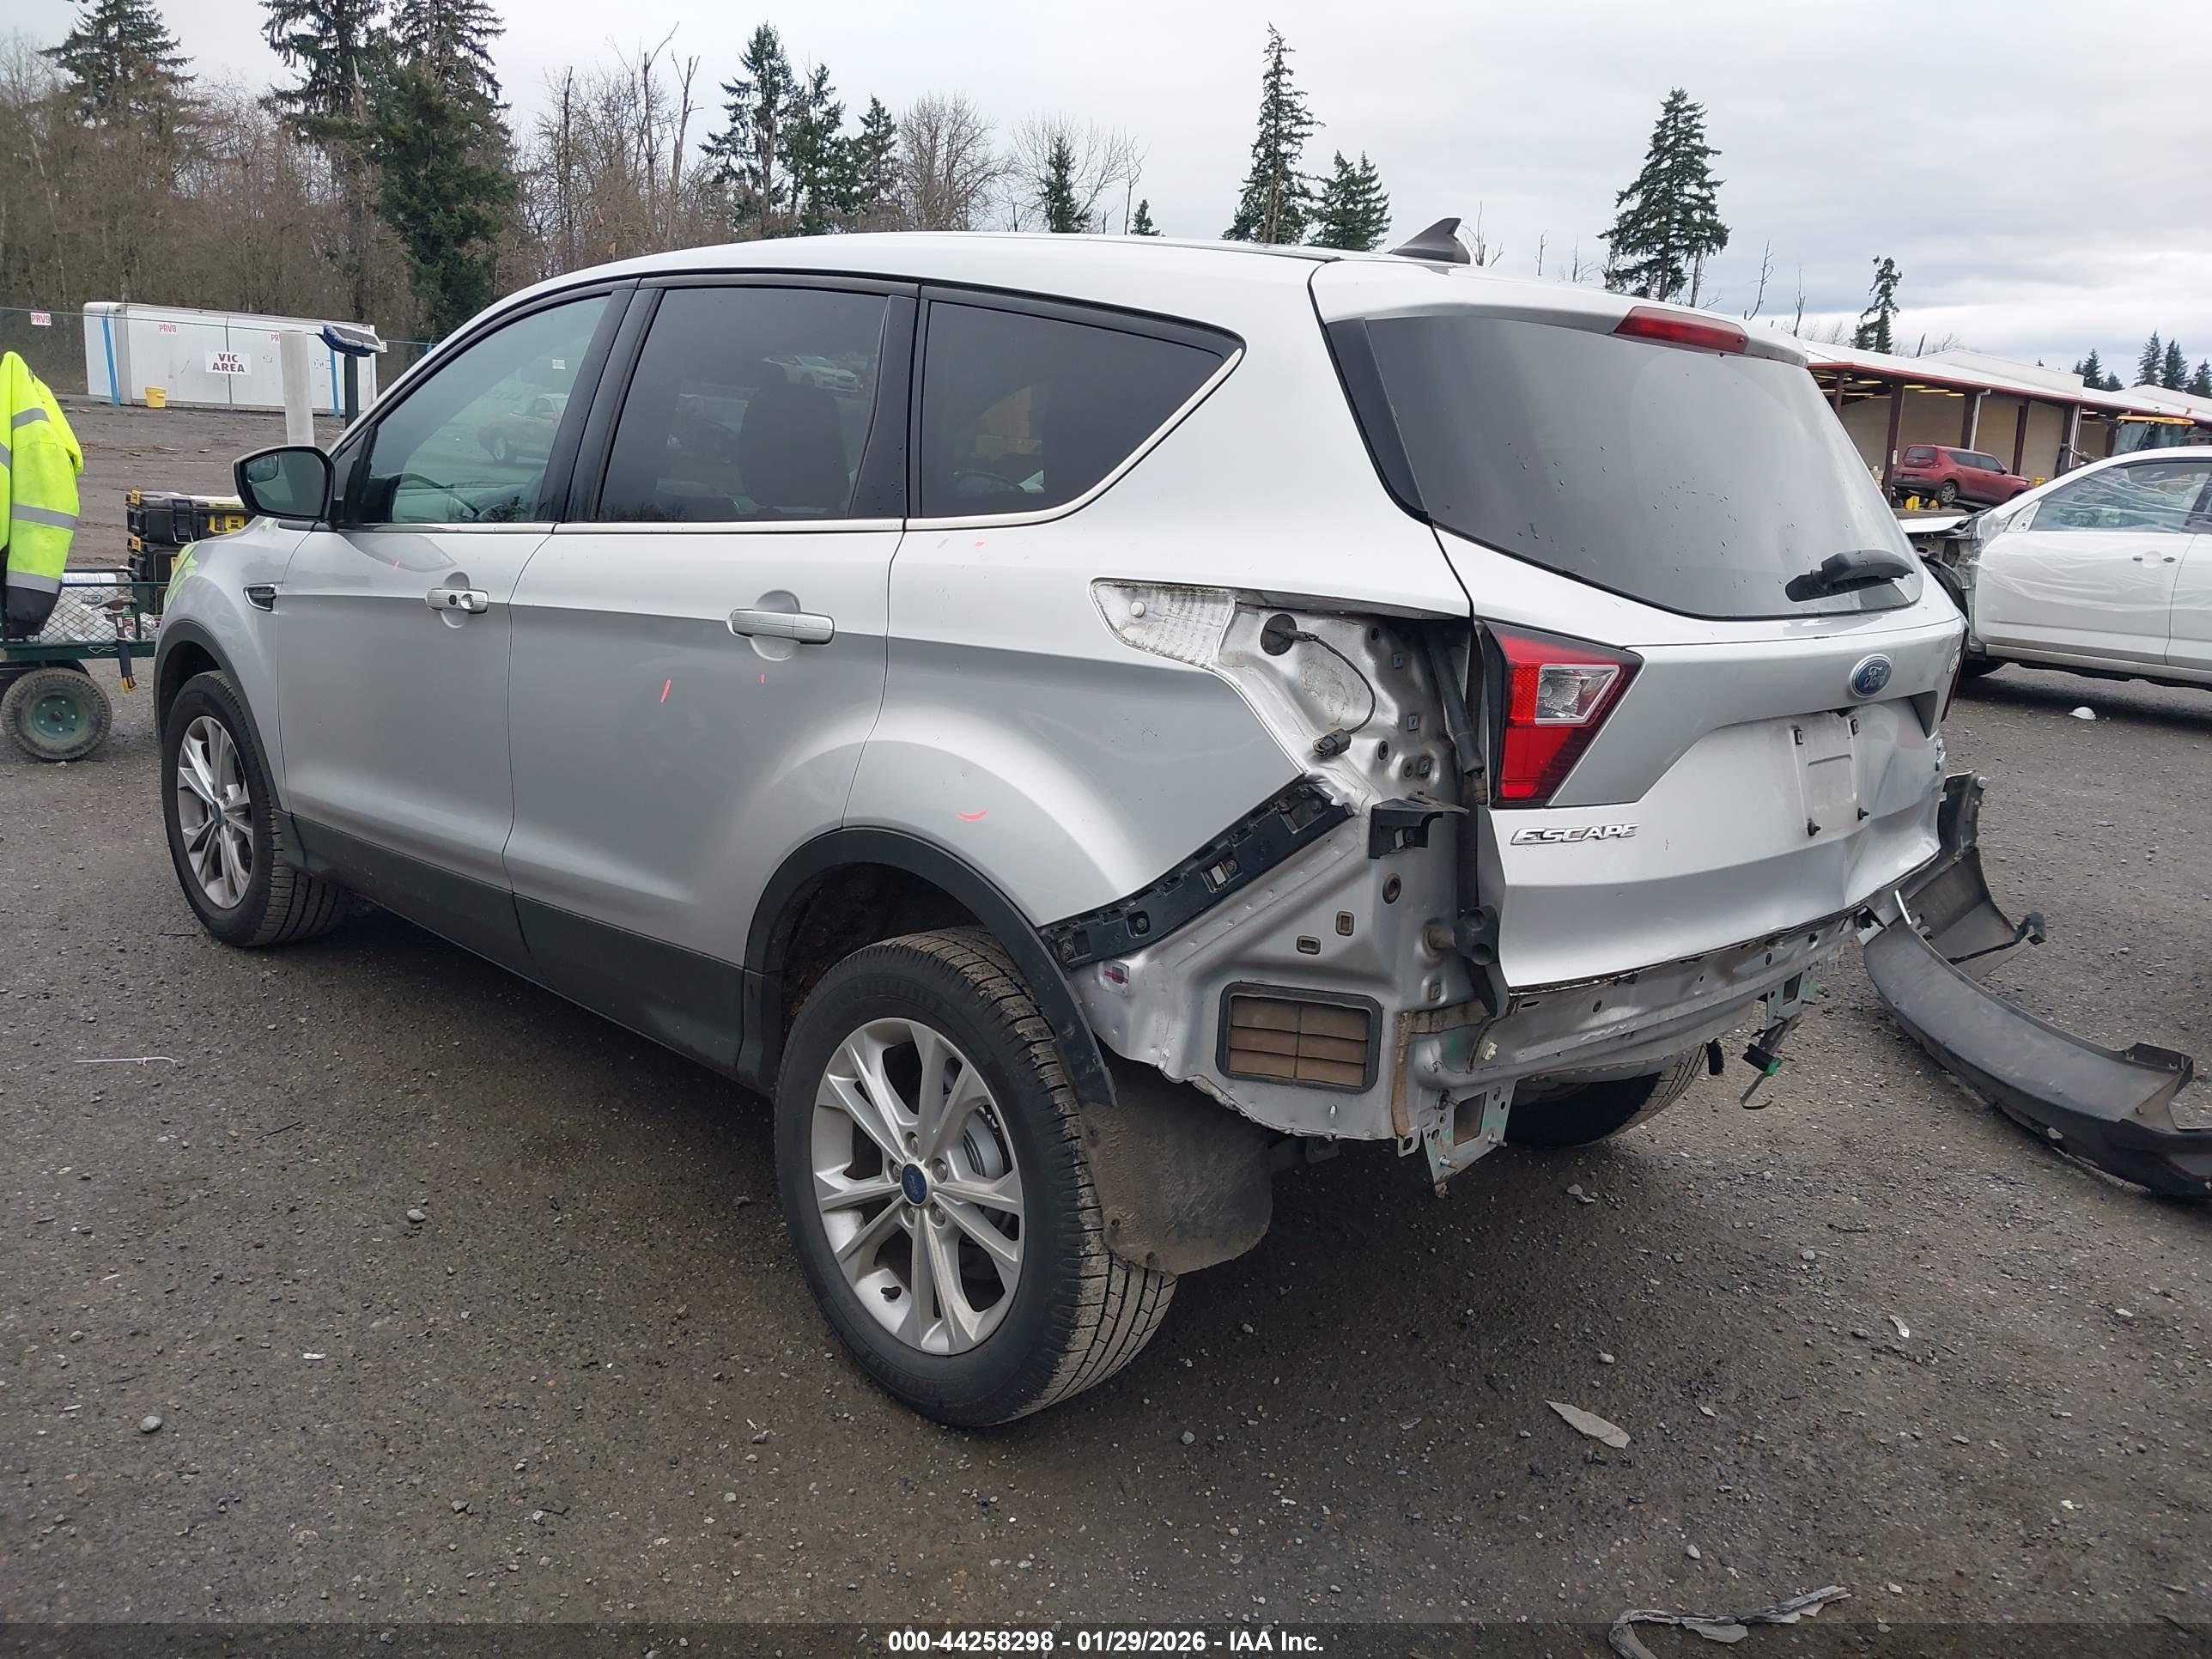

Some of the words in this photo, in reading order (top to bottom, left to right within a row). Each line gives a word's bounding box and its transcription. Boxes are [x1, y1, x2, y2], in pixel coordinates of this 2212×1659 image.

[218, 353, 238, 362] VIC
[212, 362, 245, 373] AREA
[1510, 823, 1640, 845] ESCAPE
